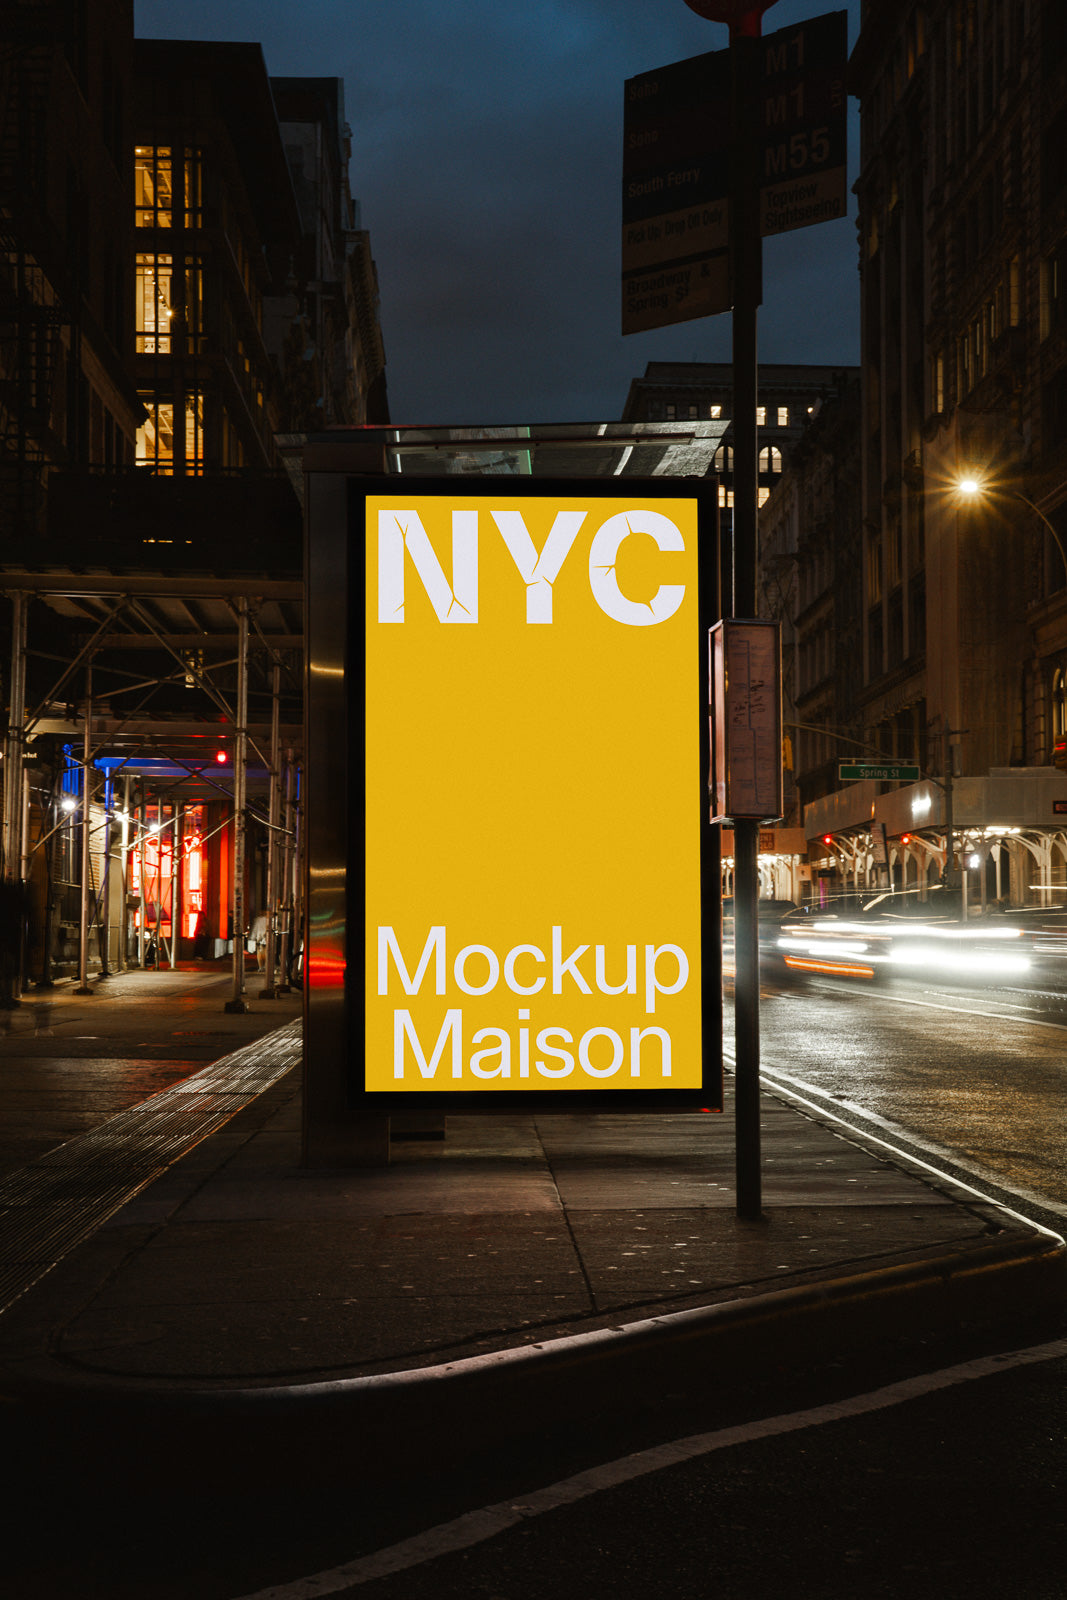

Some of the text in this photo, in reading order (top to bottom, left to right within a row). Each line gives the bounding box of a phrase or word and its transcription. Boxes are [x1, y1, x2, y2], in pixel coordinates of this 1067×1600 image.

[766, 31, 803, 75] M1
[766, 82, 803, 125] M1
[765, 127, 829, 176] M55
[628, 167, 701, 198] South Ferry
[765, 197, 840, 230] Sightseeing
[628, 263, 710, 294] Broadway &
[627, 294, 669, 315] Spring
[378, 510, 685, 626] NYC
[859, 768, 900, 779] Spring St
[378, 926, 689, 1013] Mockup
[394, 1009, 671, 1079] Maison
